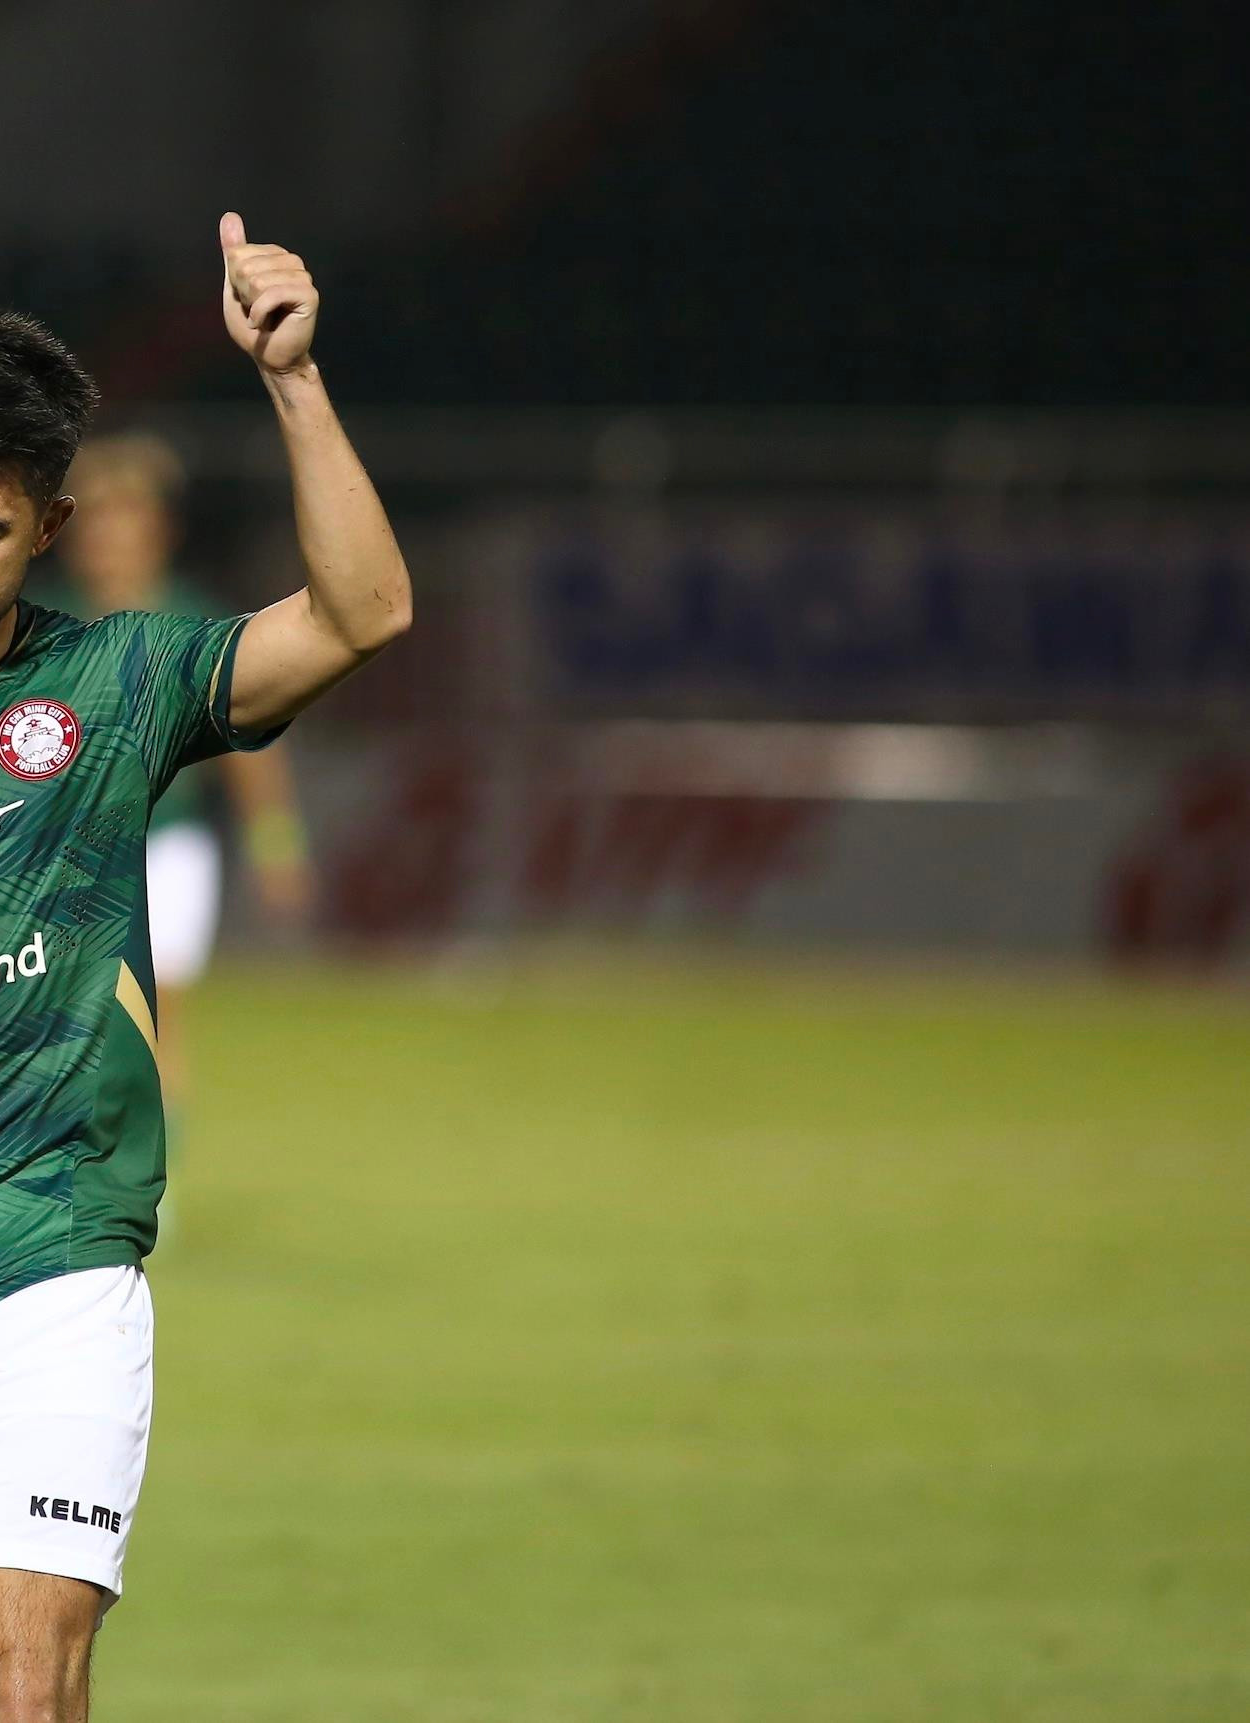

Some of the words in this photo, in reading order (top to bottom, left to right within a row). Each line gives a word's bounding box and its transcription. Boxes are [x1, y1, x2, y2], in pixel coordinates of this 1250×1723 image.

[9, 710, 24, 723] CHI
[24, 705, 47, 715] MINH
[48, 706, 66, 721] CITY
[15, 759, 54, 773] FOOTBALL
[53, 744, 70, 765] CLUB
[30, 1495, 122, 1534] KELME
